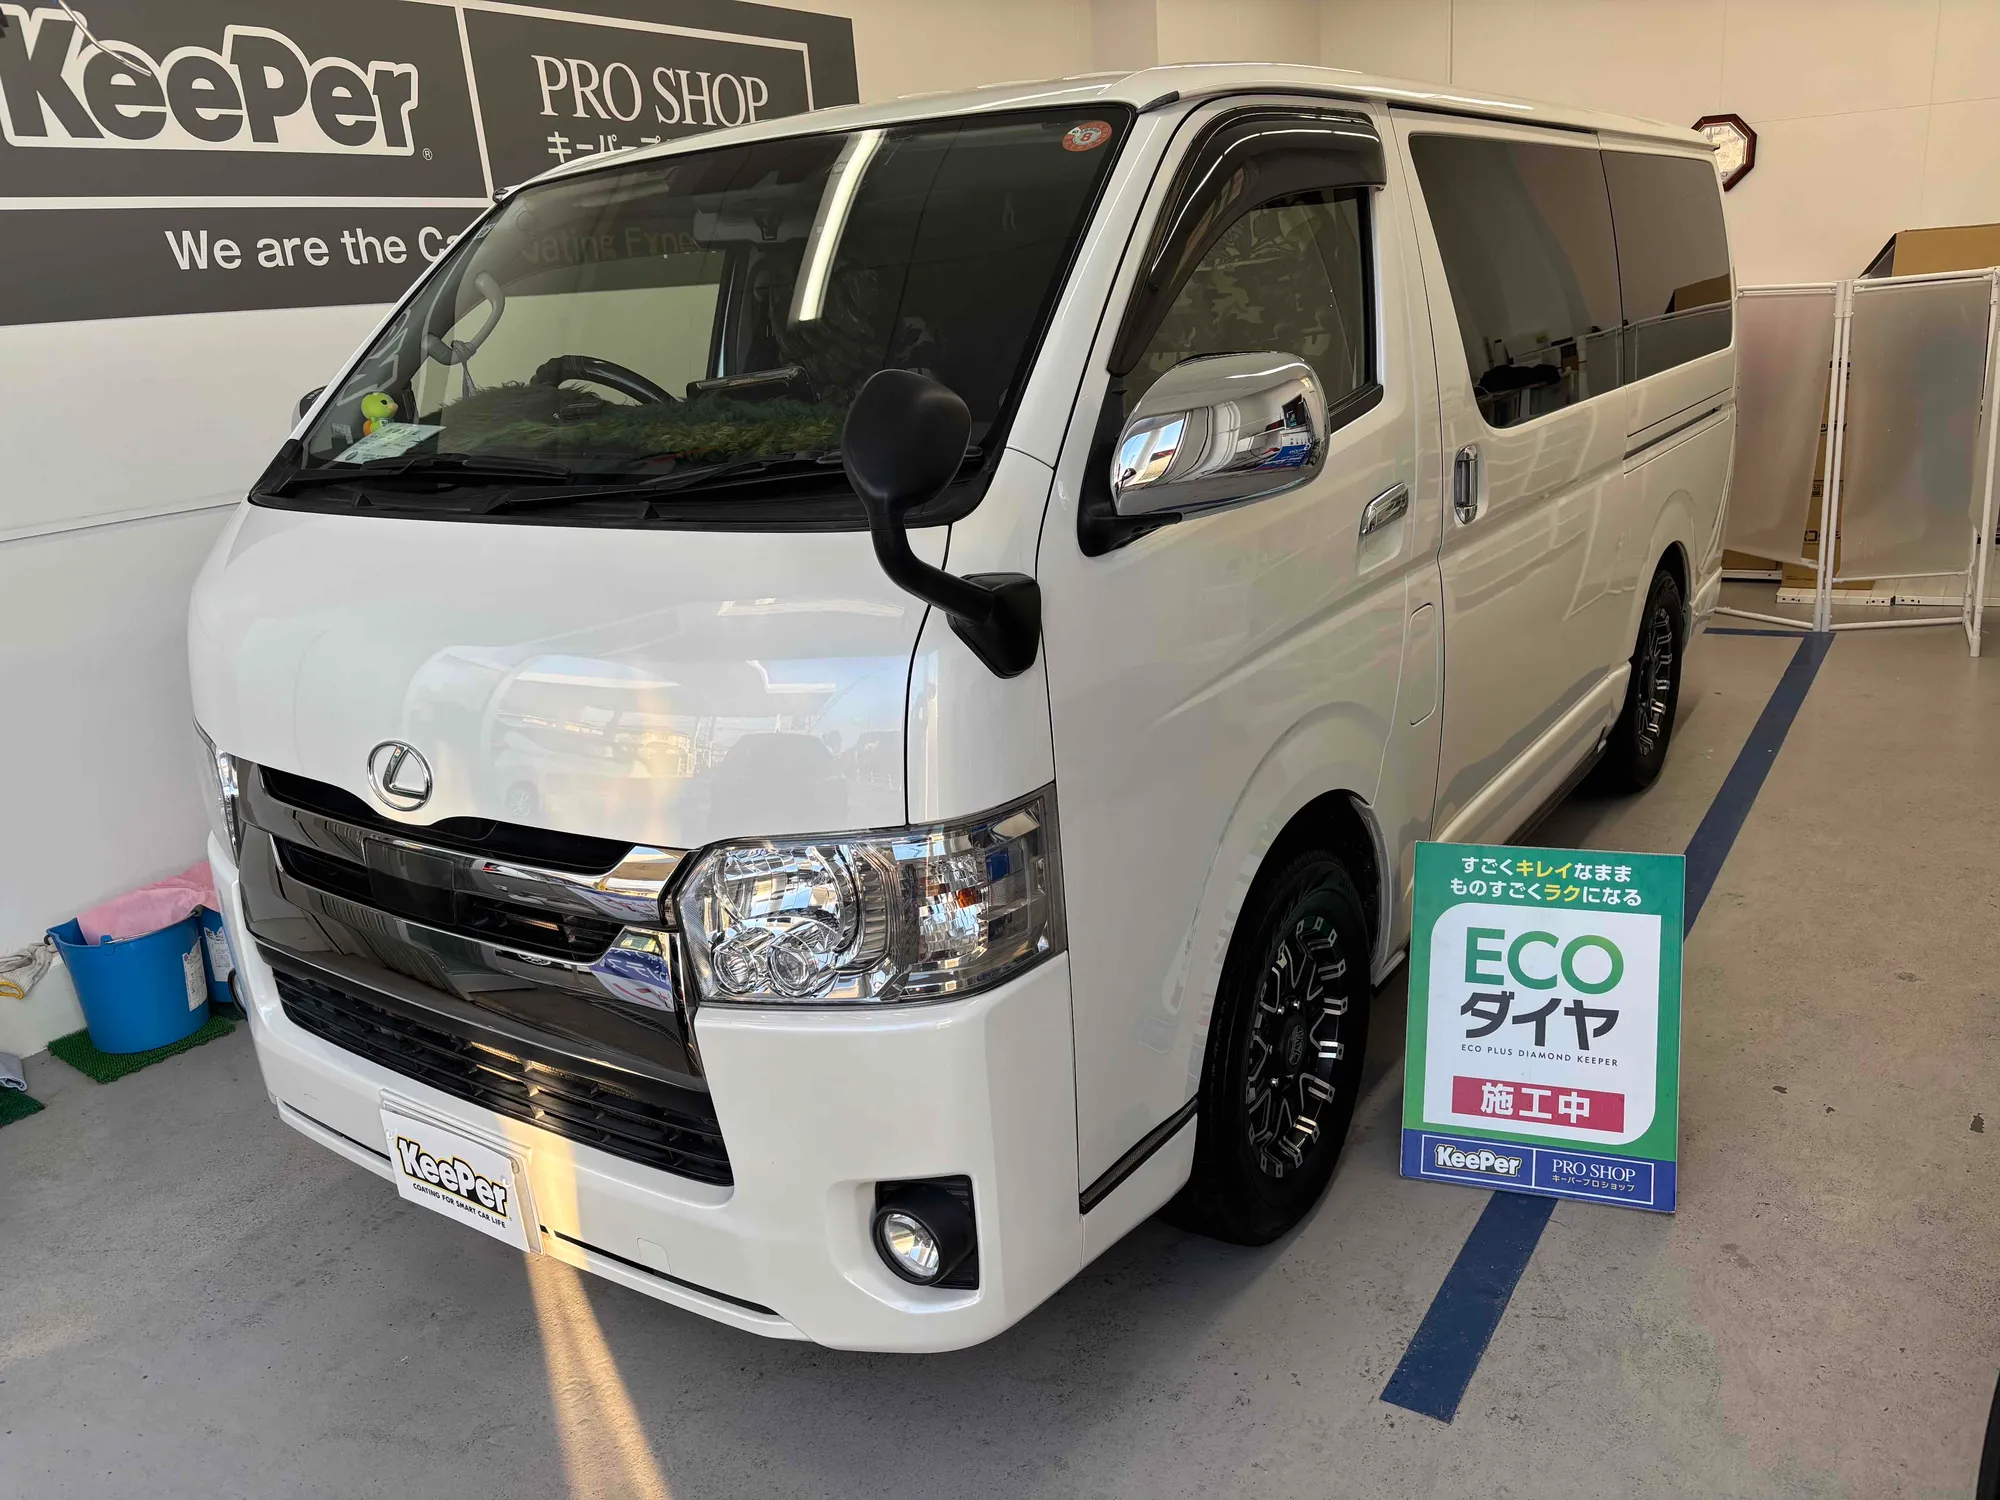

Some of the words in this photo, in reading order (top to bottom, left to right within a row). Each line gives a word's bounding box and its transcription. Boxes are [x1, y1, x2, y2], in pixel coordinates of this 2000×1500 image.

[0, 5, 418, 154] KeePer
[531, 54, 643, 122] PRO
[652, 66, 769, 128] SHOP
[164, 229, 242, 270] We
[256, 236, 330, 268] are
[340, 227, 408, 265] the
[1461, 856, 1632, 883] すごくキレイなまま
[1450, 878, 1643, 907] ものすごくラクになる
[1464, 926, 1624, 994] ECO
[1460, 991, 1619, 1051] ダイヤ
[1461, 1044, 1482, 1053] ECO
[1487, 1046, 1513, 1056] PLUS
[1518, 1049, 1571, 1062] DIAMOND
[1577, 1055, 1618, 1067] KEEPER
[1480, 1082, 1590, 1124] 施工中
[397, 1136, 508, 1218] KeePer
[1434, 1143, 1523, 1178] KeePer
[1552, 1158, 1587, 1176] PRO
[1589, 1164, 1636, 1183] SHOP
[1552, 1174, 1635, 1192] キーパープロショップ
[412, 1182, 441, 1199] COATING
[442, 1193, 455, 1206] FOR
[455, 1200, 477, 1215] SMART
[477, 1210, 491, 1221] CAR
[491, 1216, 507, 1229] LIFE
